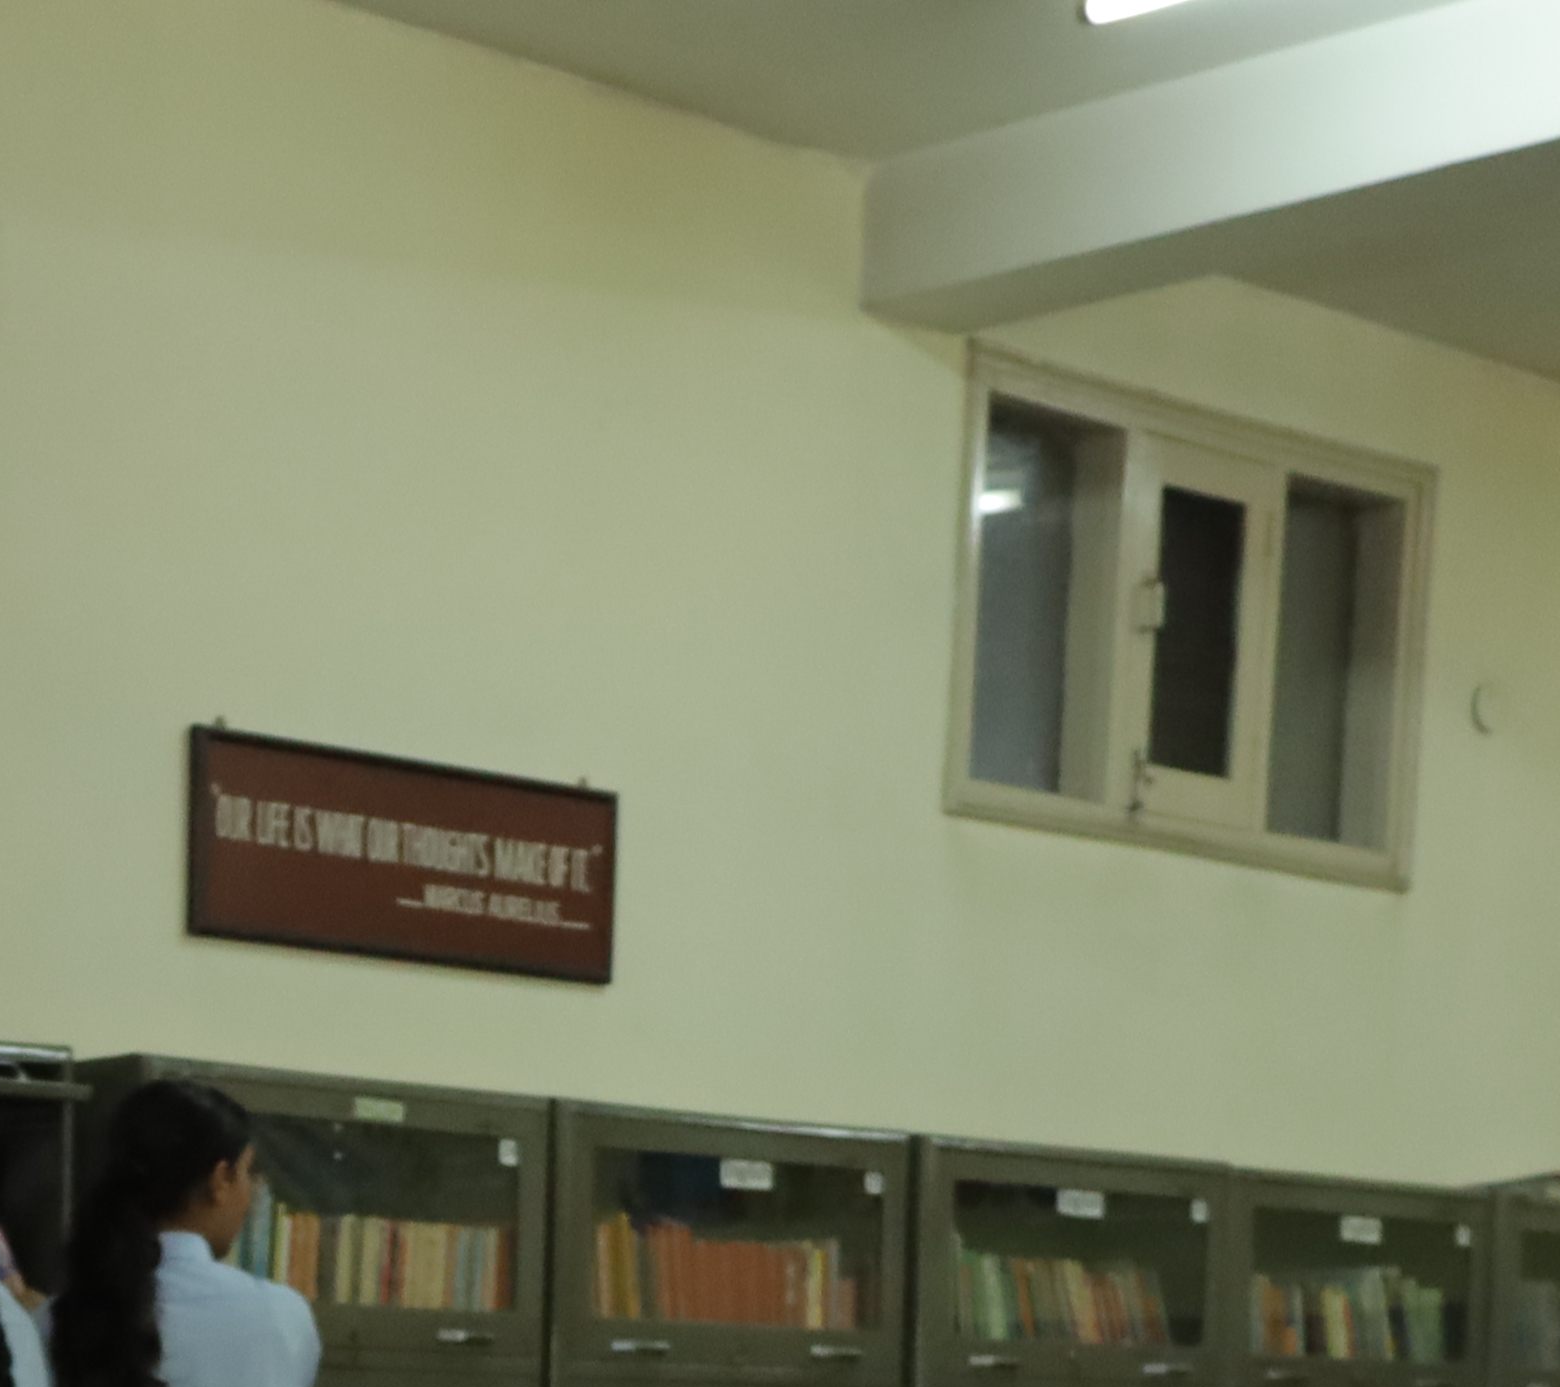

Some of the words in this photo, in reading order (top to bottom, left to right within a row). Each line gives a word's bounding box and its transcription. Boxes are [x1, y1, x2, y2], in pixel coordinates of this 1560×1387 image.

[255, 799, 292, 849] LIFE
[293, 805, 315, 852] IS
[316, 808, 367, 859] WHAT
[366, 815, 401, 865] OUR
[400, 822, 492, 878] THOUGHTS
[493, 836, 548, 886] MAKE
[547, 844, 570, 888] OF
